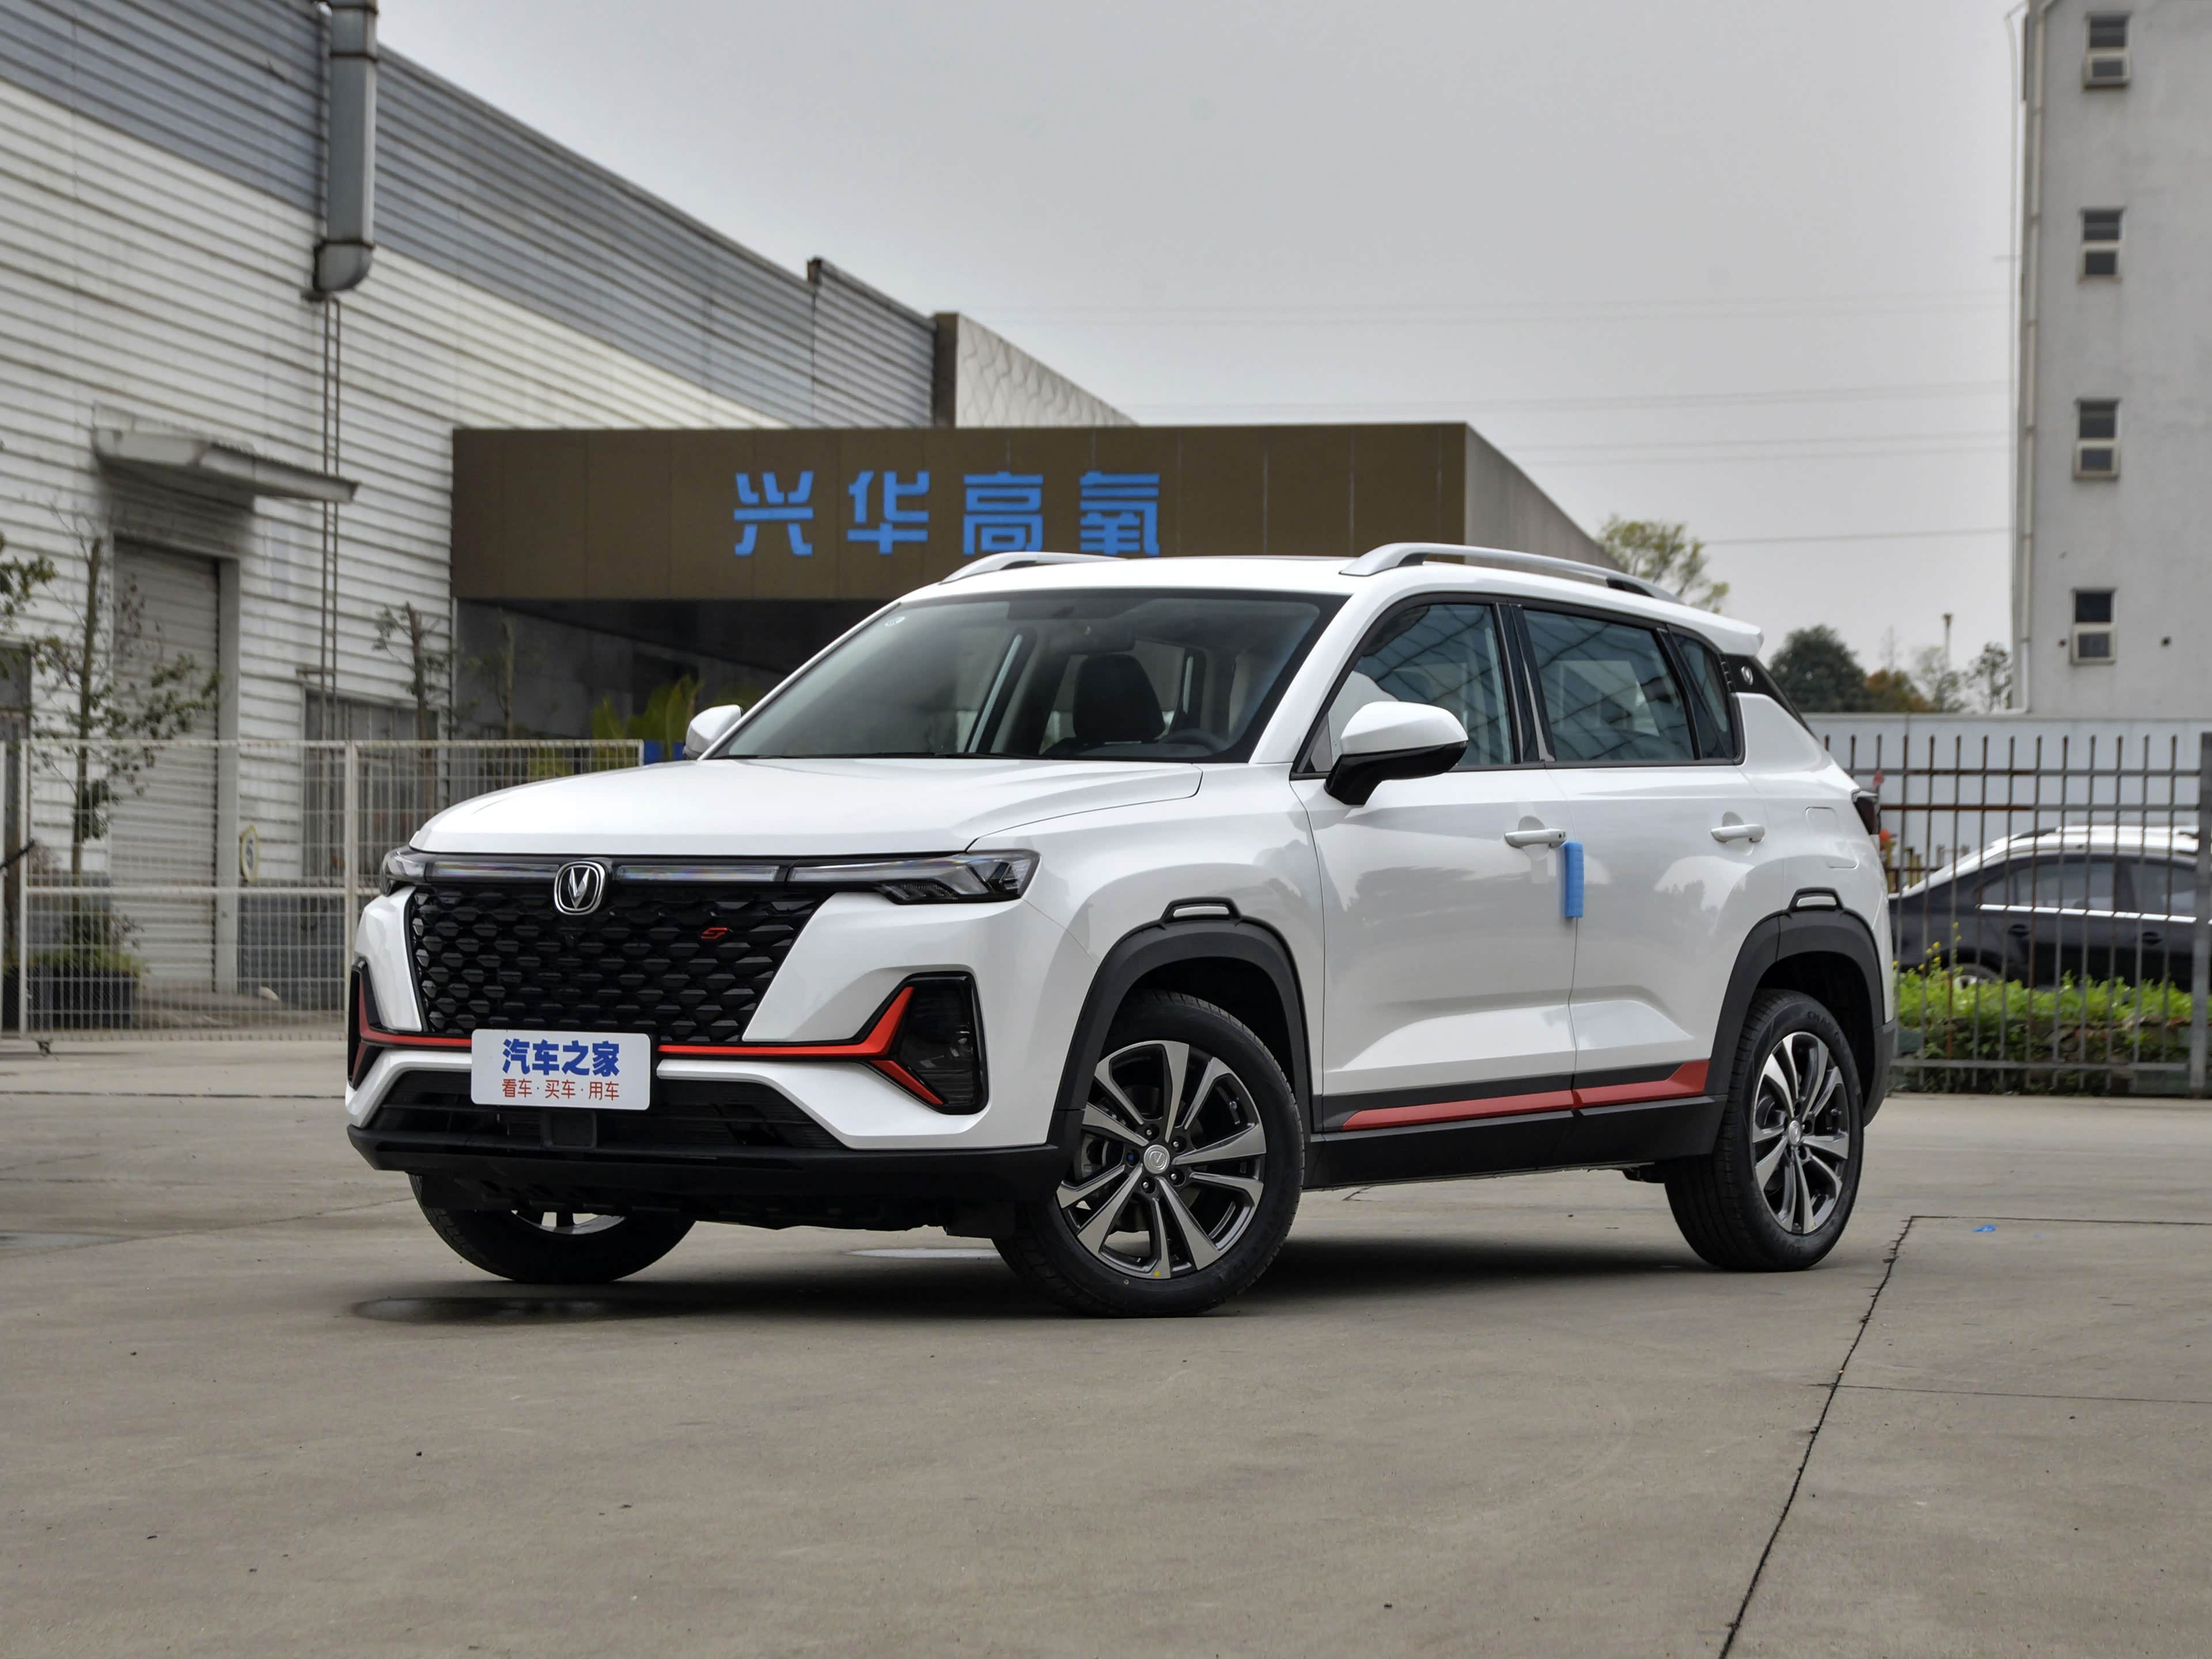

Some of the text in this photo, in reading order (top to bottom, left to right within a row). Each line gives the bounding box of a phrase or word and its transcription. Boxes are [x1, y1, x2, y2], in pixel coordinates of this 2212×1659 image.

[734, 469, 1161, 558] 兴华高氧
[502, 1037, 620, 1077] 汽车之家
